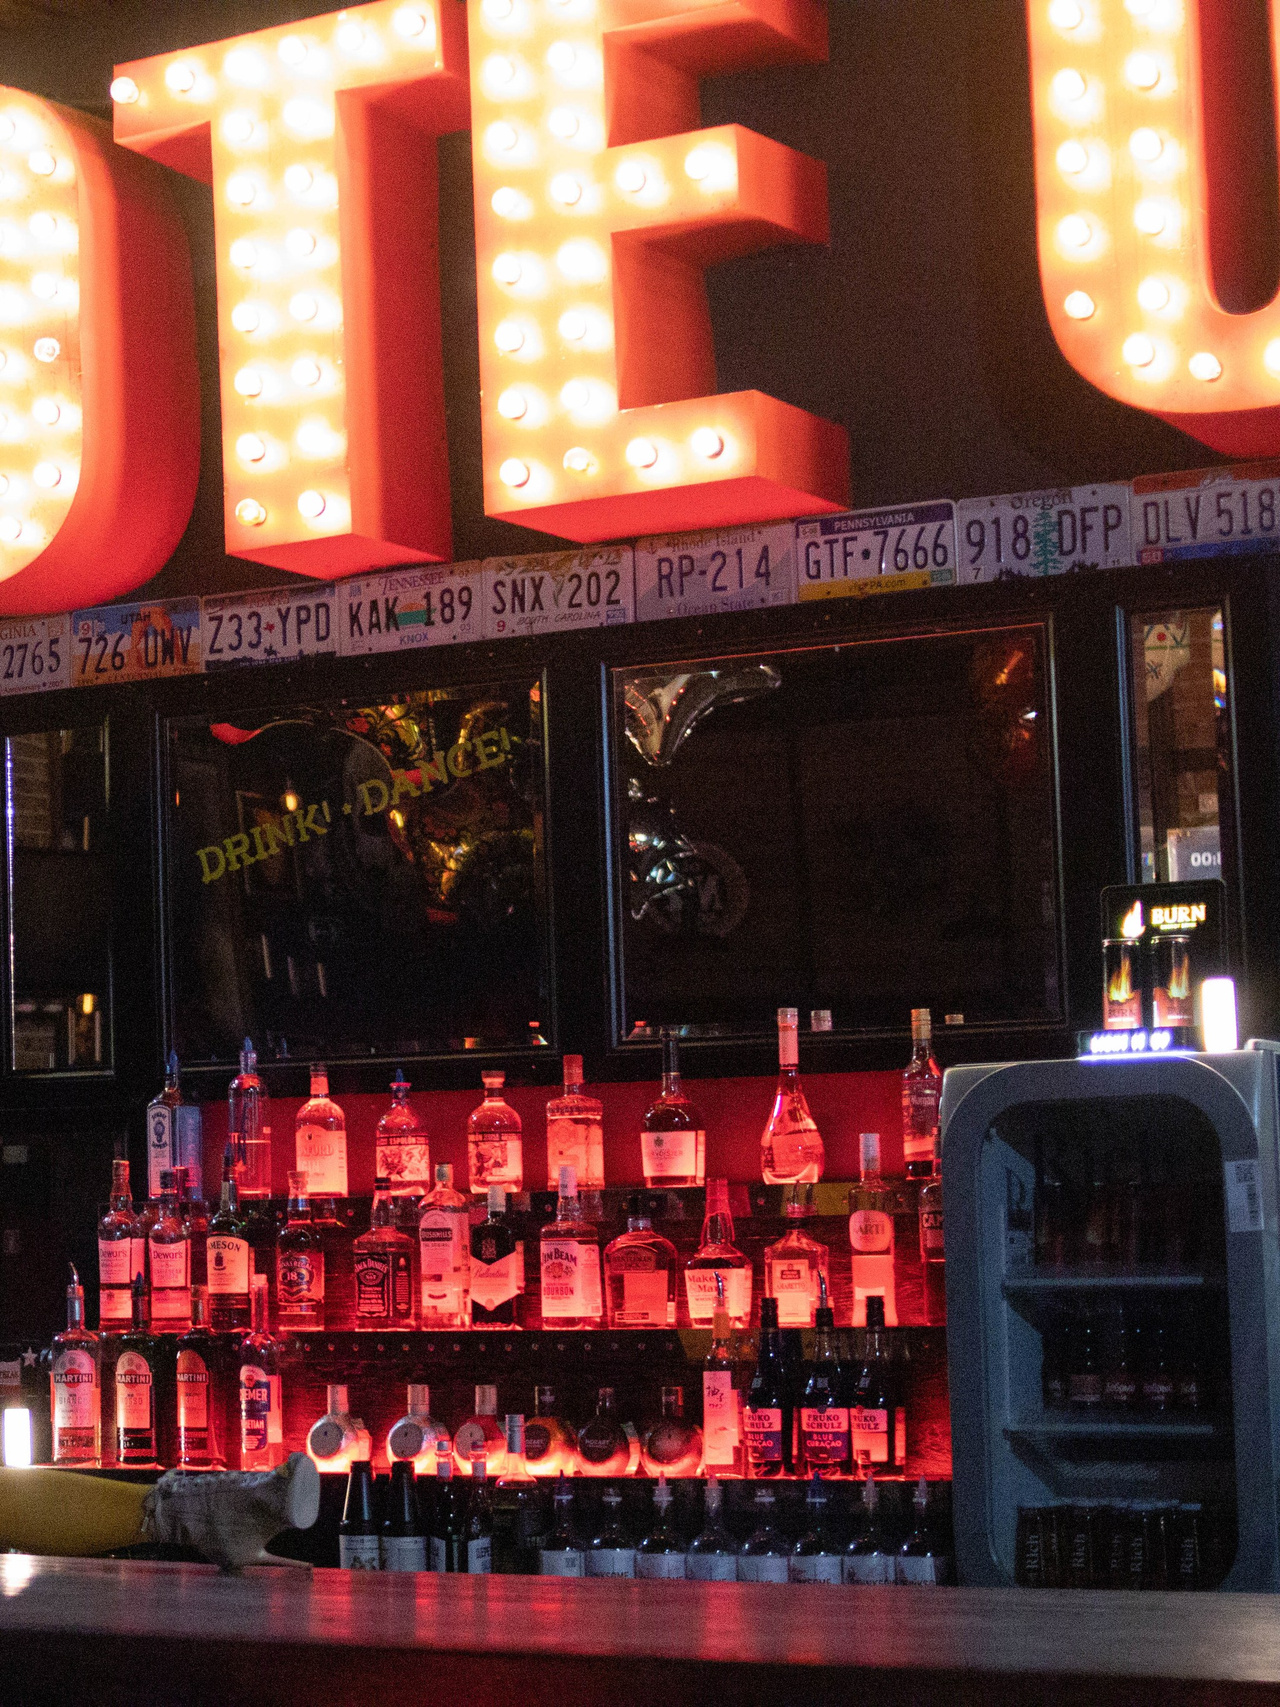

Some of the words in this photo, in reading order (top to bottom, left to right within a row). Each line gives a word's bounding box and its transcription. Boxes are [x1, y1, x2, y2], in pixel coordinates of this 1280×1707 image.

[1011, 489, 1073, 510] Oregon
[834, 512, 915, 532] PENNSYLVANIA
[1143, 495, 1201, 545] DLV
[671, 536, 711, 553] Rhode
[716, 530, 755, 547] Island
[966, 514, 1032, 565] 918
[1057, 504, 1122, 557] DFP
[657, 544, 771, 598] RP-214
[972, 567, 981, 580] 7
[379, 571, 445, 596] TENNESSEE
[492, 576, 545, 615] SNX
[568, 570, 621, 608] 202
[349, 596, 400, 638] KAK
[423, 585, 472, 627] 189
[677, 600, 717, 616] Ocean
[720, 596, 755, 610] State
[121, 611, 151, 624] UTAH
[496, 620, 506, 633] 9
[554, 611, 601, 623] CAROLINA
[208, 610, 262, 655] Z33
[277, 603, 331, 647] YPD
[399, 632, 429, 646] KNOX
[78, 633, 125, 675] 726
[196, 801, 331, 885] DRINK!
[357, 727, 513, 817] DANCE!
[1150, 903, 1207, 926] BURN
[555, 1247, 577, 1267] BEAM
[286, 1271, 298, 1281] 18
[54, 1373, 93, 1384] MARTINI
[117, 1373, 151, 1384] MARTINI
[176, 1372, 207, 1383] MARTINI
[746, 1414, 770, 1423] RUKO
[806, 1421, 842, 1430] SCHULZ
[807, 1414, 840, 1422] FRUKO
[812, 1433, 834, 1441] BLUE
